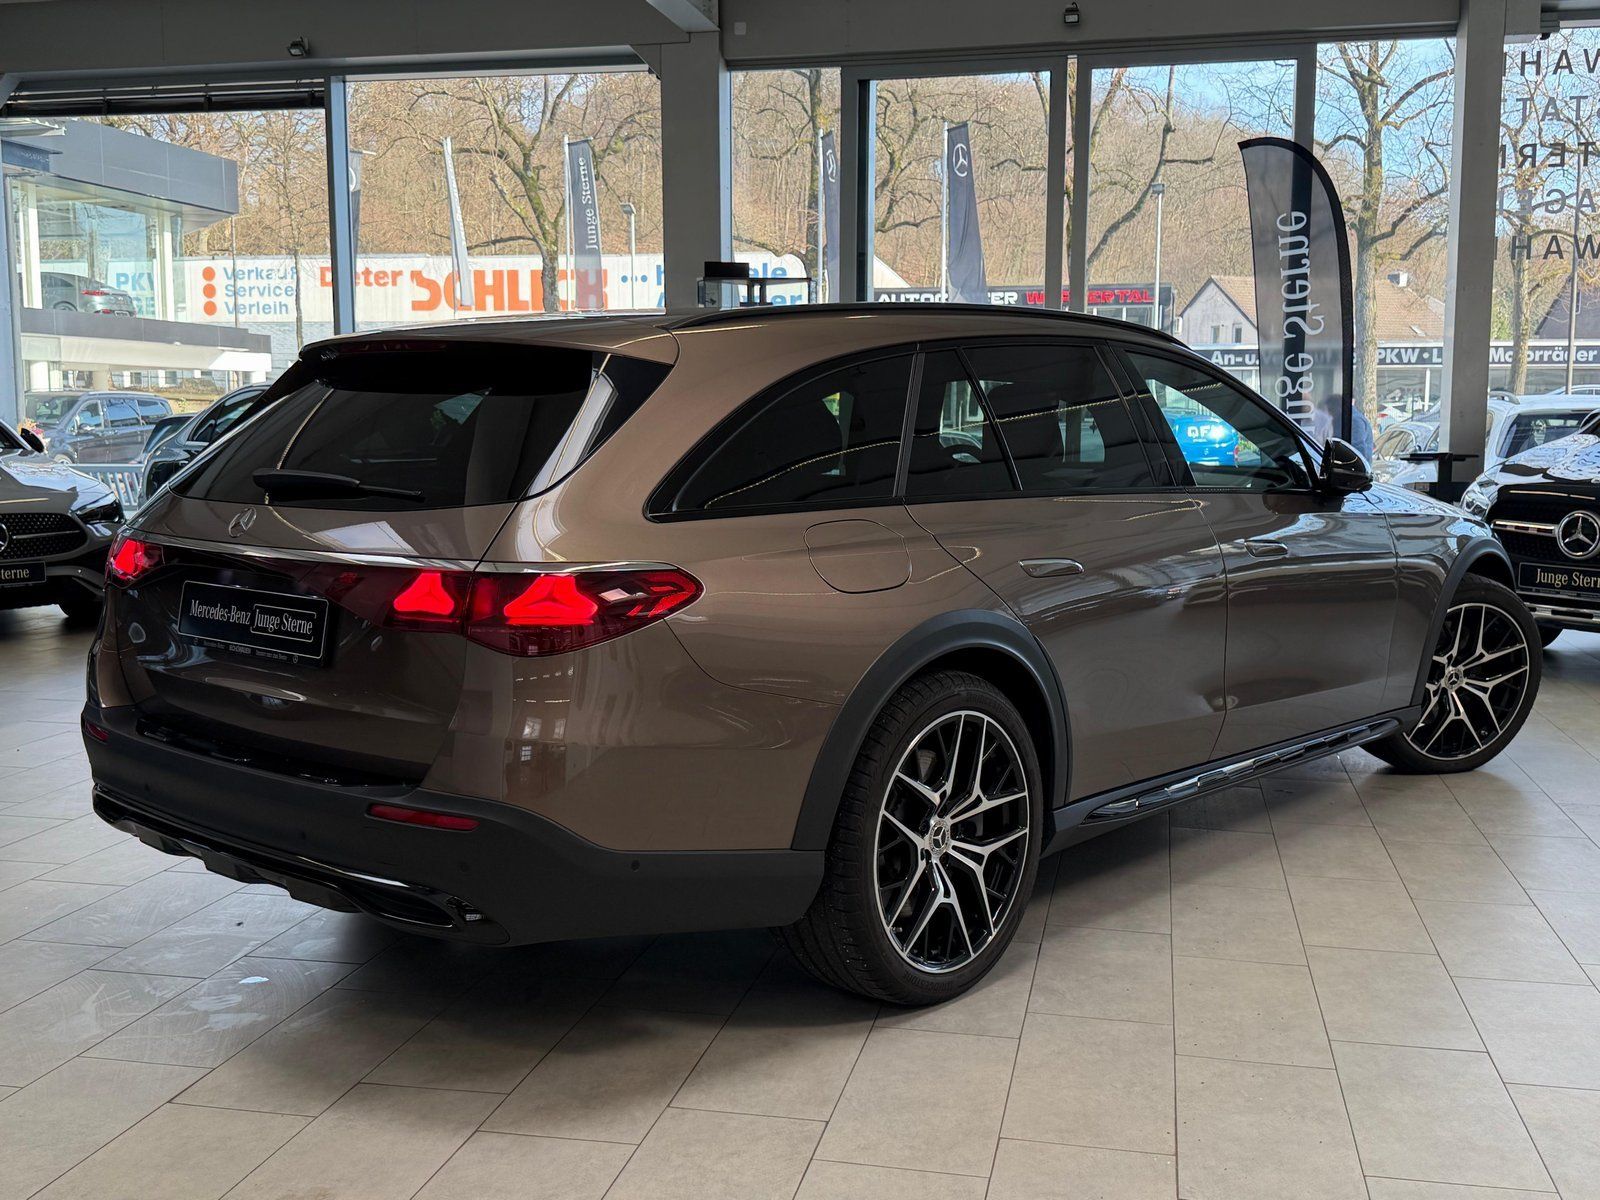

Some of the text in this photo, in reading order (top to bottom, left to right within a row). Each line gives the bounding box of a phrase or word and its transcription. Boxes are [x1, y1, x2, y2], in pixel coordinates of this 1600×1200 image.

[577, 157, 599, 251] Junge Sterne
[223, 266, 296, 280] Verkauf
[319, 266, 404, 288] Dter
[224, 283, 294, 298] Service
[878, 289, 1155, 305] AUTOER WPERTAL
[224, 300, 288, 315] Verleih
[1489, 345, 1598, 363] Moorräder
[0, 568, 30, 580] terne
[1535, 568, 1568, 588] Junge
[189, 599, 313, 635] Mercedes-Benz Junge Sterne
